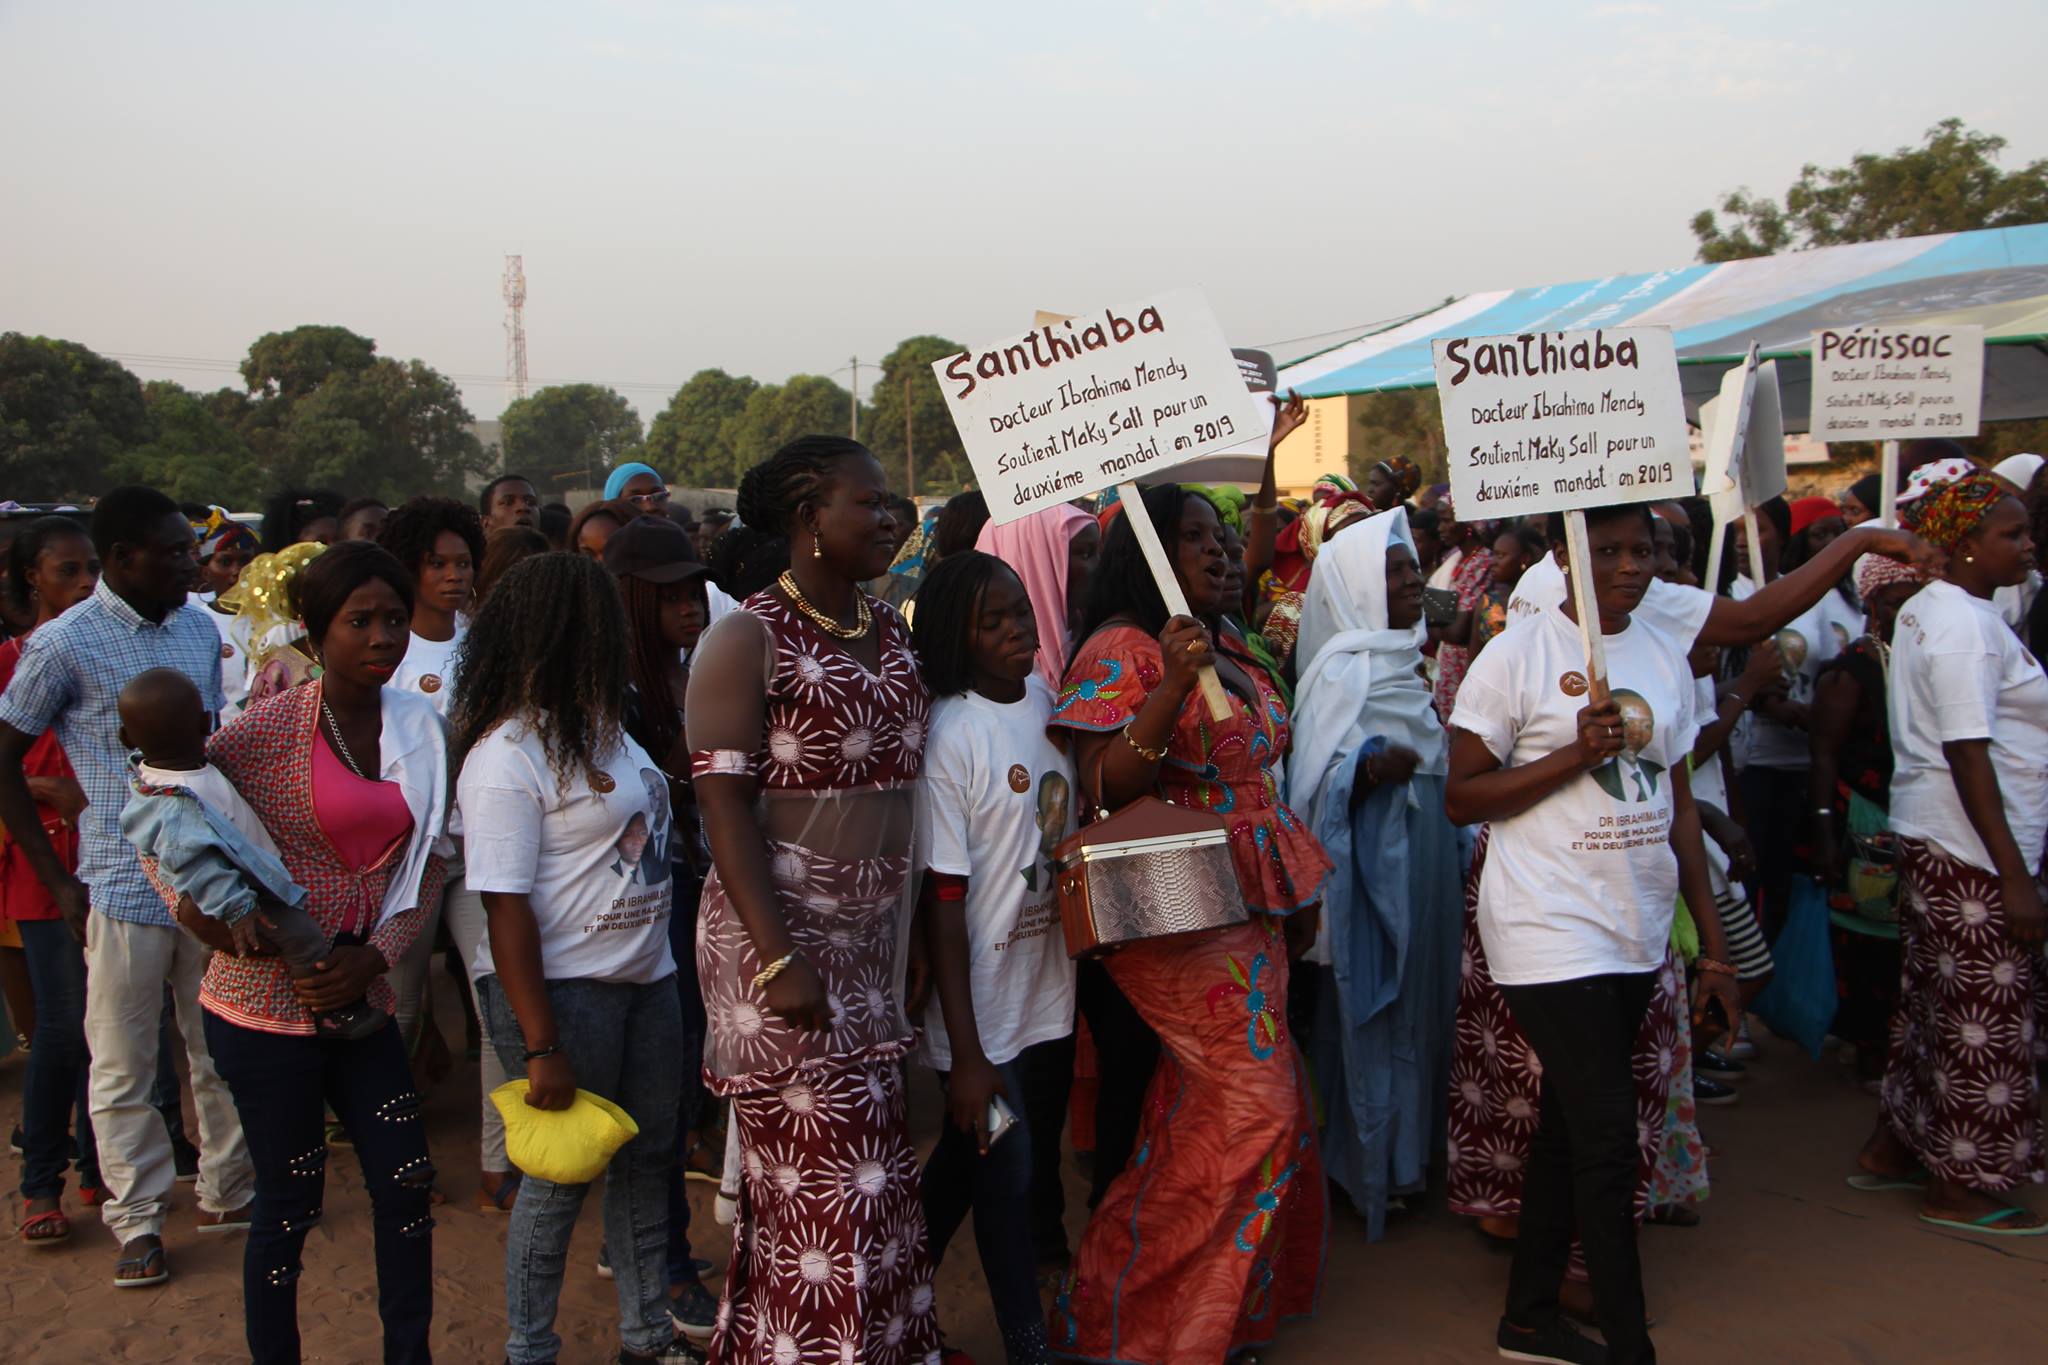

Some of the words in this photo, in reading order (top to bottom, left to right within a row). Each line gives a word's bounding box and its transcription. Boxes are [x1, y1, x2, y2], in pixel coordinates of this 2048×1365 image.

[946, 306, 1164, 400] Santhiaba
[1447, 329, 1638, 386] Santhiaba
[1821, 328, 1952, 361] Périssac
[989, 399, 1053, 433] Docteur
[1057, 375, 1132, 409] Ibrahima
[1134, 357, 1187, 385] Mendy
[1472, 399, 1528, 424] Docteur
[1532, 391, 1594, 420] Ibrahima
[1601, 390, 1644, 416] Mendy
[997, 436, 1061, 474] Soutient
[1109, 406, 1144, 436] Sall
[1100, 435, 1160, 475] mandat
[1194, 415, 1234, 443] 2019
[1469, 440, 1526, 467] Soutient
[1569, 432, 1597, 457] Sall
[1554, 465, 1607, 493] mandat
[1638, 462, 1672, 484] 2019
[1584, 831, 1613, 839] POUR
[1599, 816, 1614, 827] DR
[597, 913, 621, 921] POUR
[612, 899, 624, 909] DR
[597, 923, 609, 931] UN
[995, 943, 1006, 951] ET
